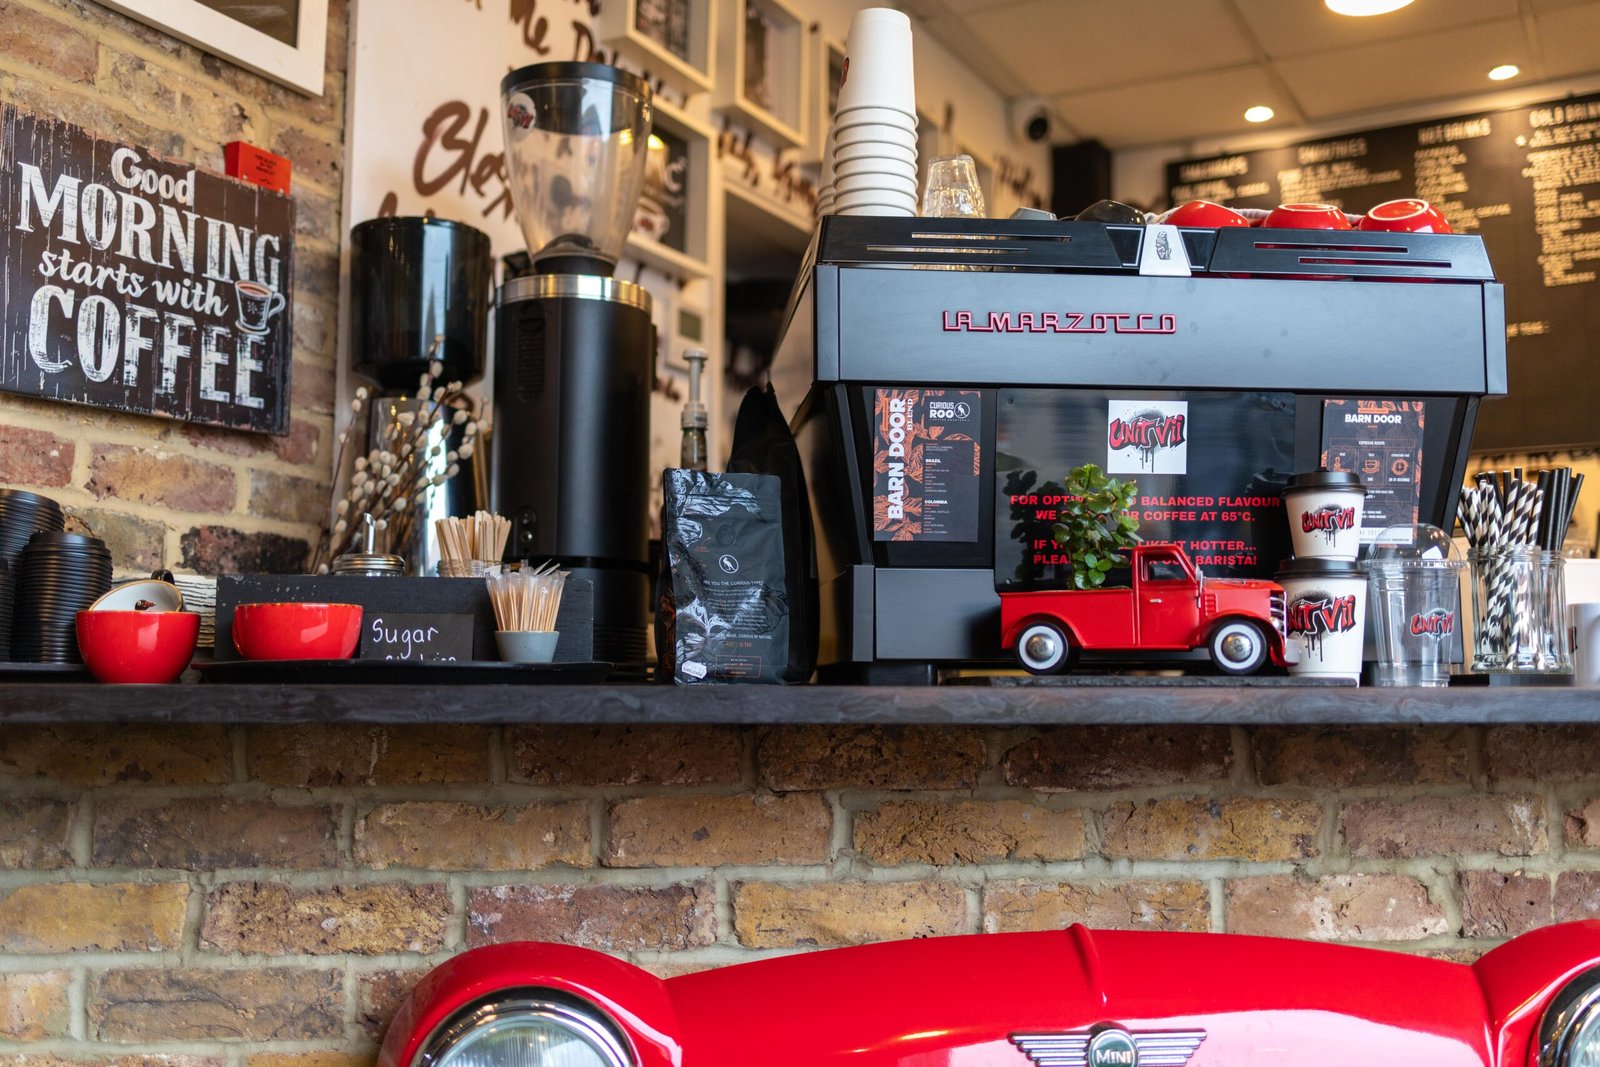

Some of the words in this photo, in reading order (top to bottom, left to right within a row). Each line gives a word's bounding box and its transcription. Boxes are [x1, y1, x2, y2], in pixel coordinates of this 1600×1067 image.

[110, 147, 196, 207] Good
[15, 161, 281, 293] MORNING
[38, 249, 148, 298] starts
[152, 277, 229, 318] with
[943, 311, 975, 332] LA
[28, 284, 266, 411] COFFEE
[929, 401, 954, 410] CURIOUS
[929, 409, 954, 419] ROO
[888, 398, 906, 457] DOOR
[1344, 414, 1372, 423] BARN
[1373, 414, 1402, 424] DOOR
[888, 462, 904, 519] BARN
[1010, 495, 1038, 505] FOR
[1141, 496, 1214, 507] BALANCED
[1218, 496, 1281, 507] FLAVOUR
[1036, 510, 1057, 520] WE
[1143, 511, 1196, 521] COFFEE
[1200, 511, 1218, 521] AT
[1034, 540, 1047, 550] IF
[1190, 540, 1257, 551] HOTTER...
[1195, 555, 1257, 566] BARISTA!
[372, 618, 439, 660] Sugar
[1095, 1049, 1133, 1065] MINI
